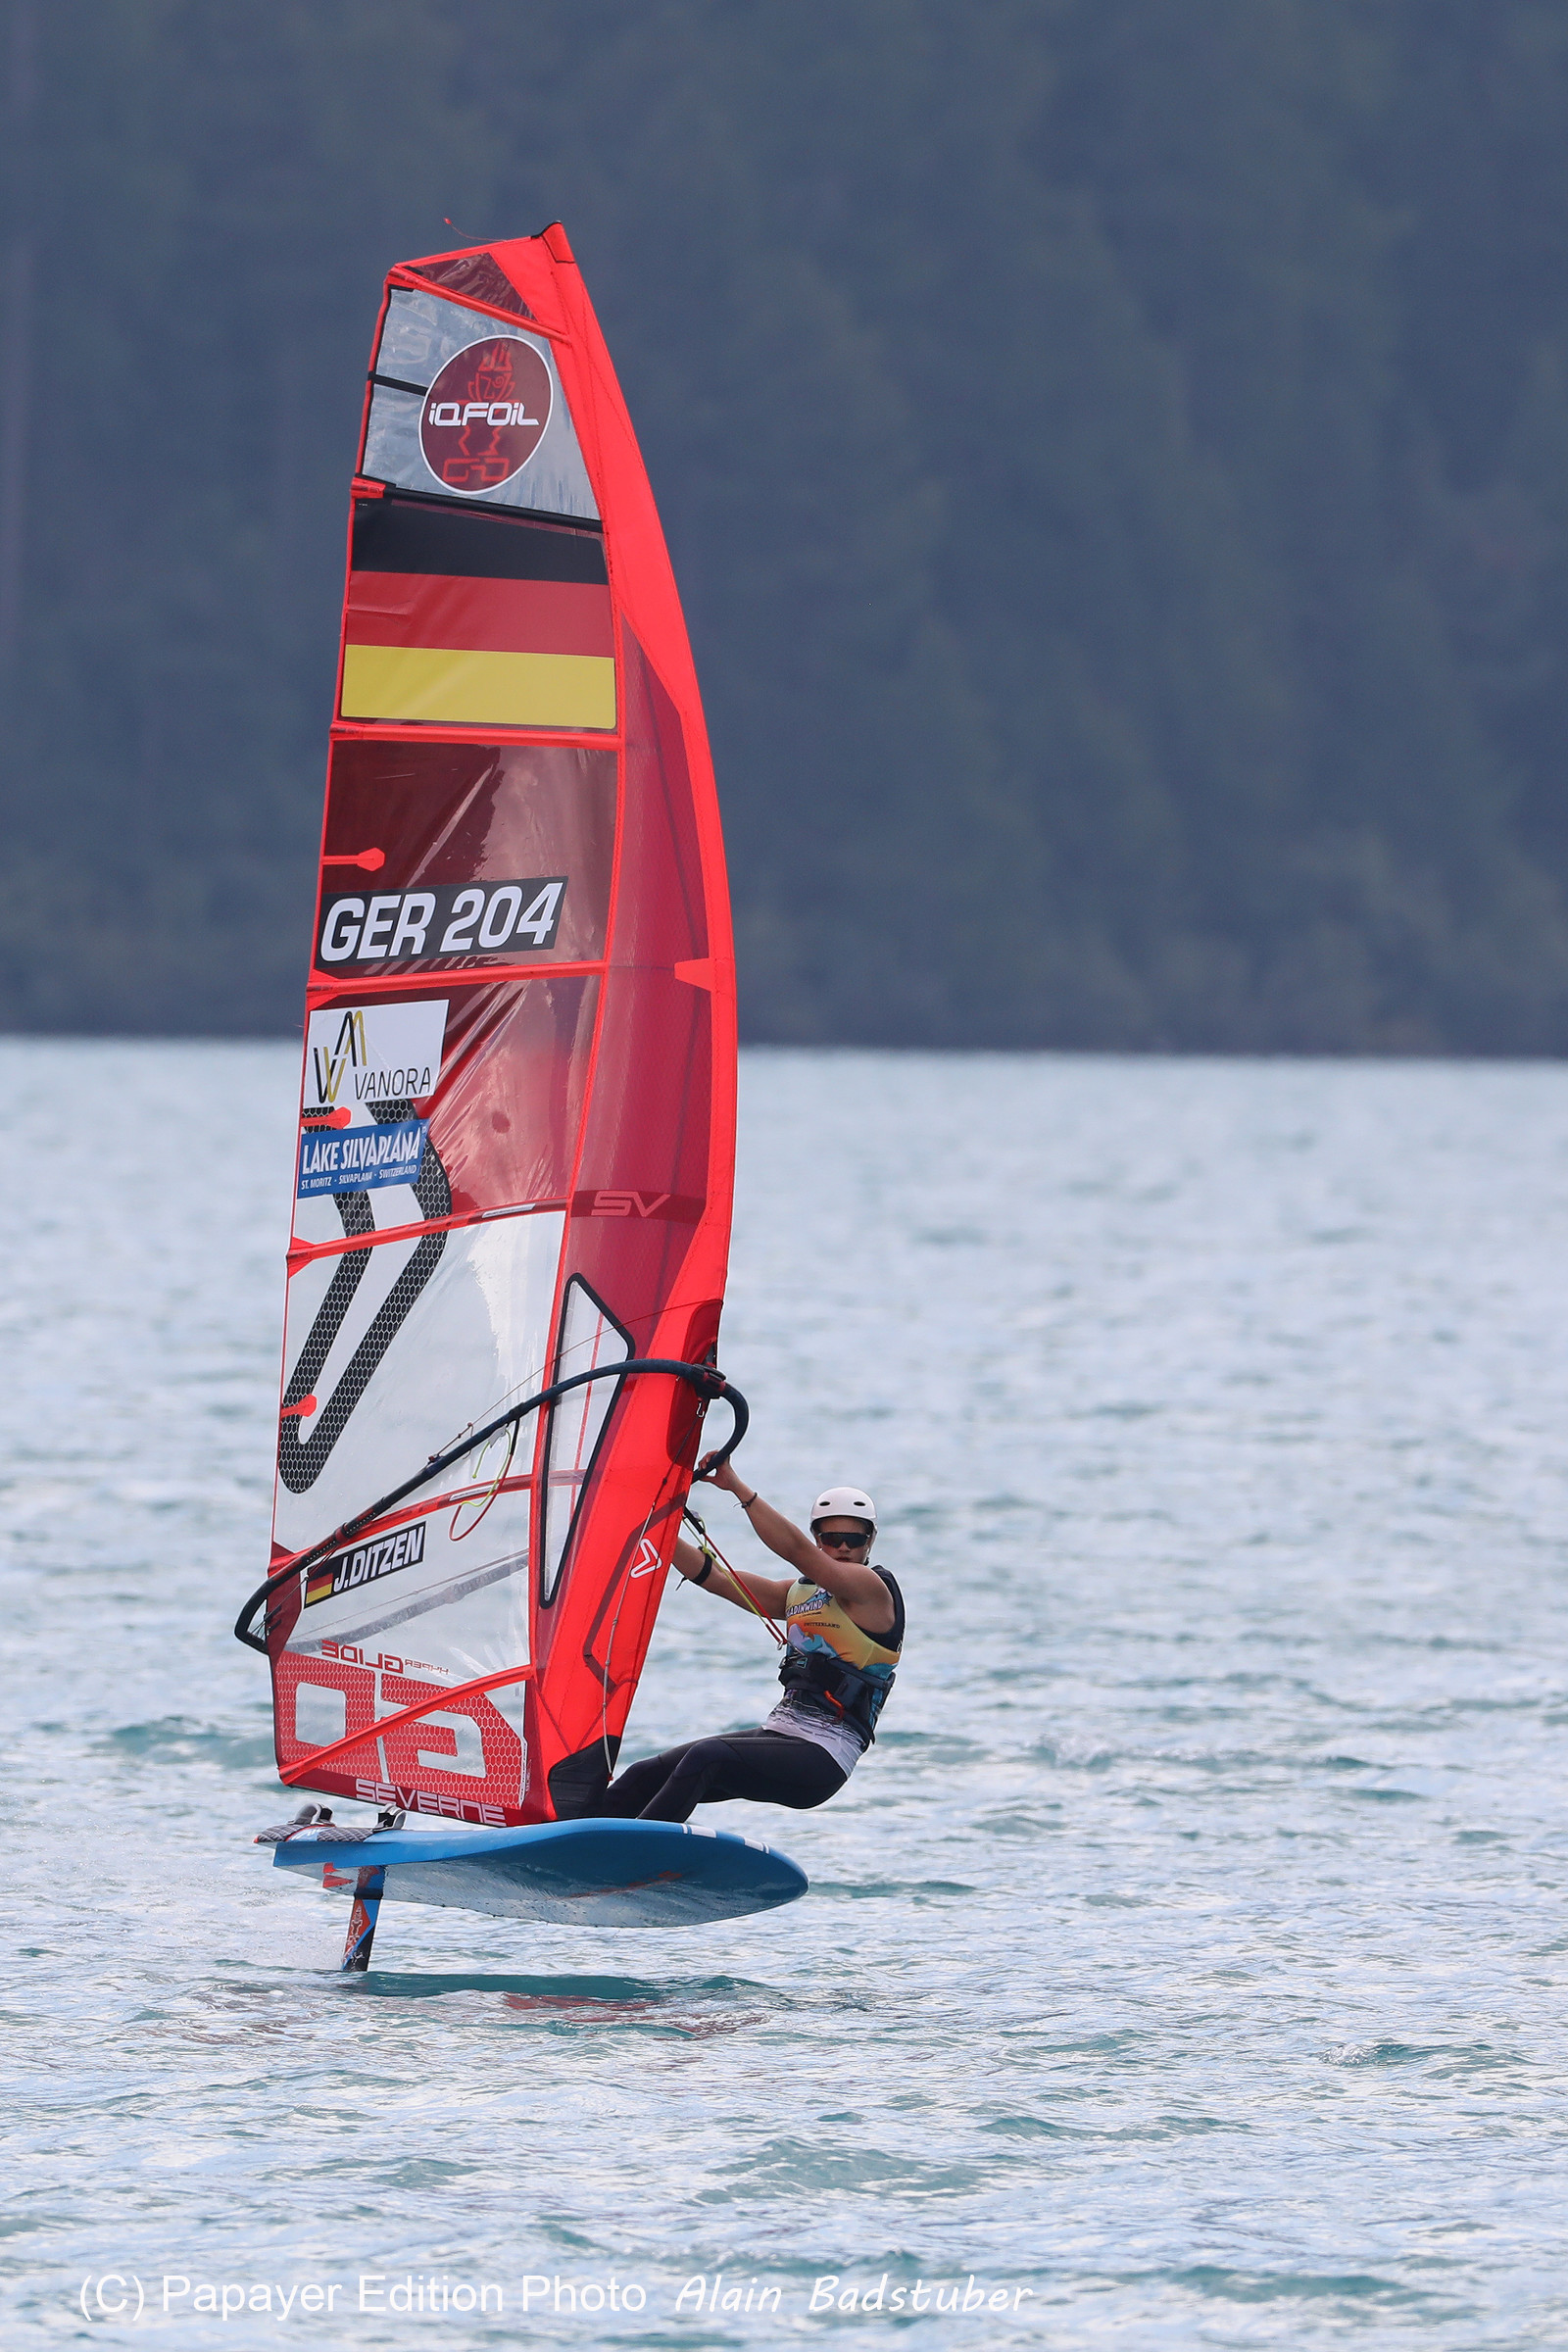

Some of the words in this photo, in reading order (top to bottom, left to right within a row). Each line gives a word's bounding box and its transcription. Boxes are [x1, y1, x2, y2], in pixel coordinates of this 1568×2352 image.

[320, 892, 436, 962] GER
[439, 882, 564, 953] 204
[355, 1066, 431, 1100] VANORA
[302, 1139, 341, 1175] LAKE
[340, 1127, 420, 1171] SILVAPLANA
[310, 1176, 332, 1189] MORITZ
[379, 1164, 417, 1180] SWITZERLAND
[590, 1190, 671, 1218] SV
[332, 1526, 425, 1593] J.DITZEN
[355, 1778, 507, 1827] SEVERNE
